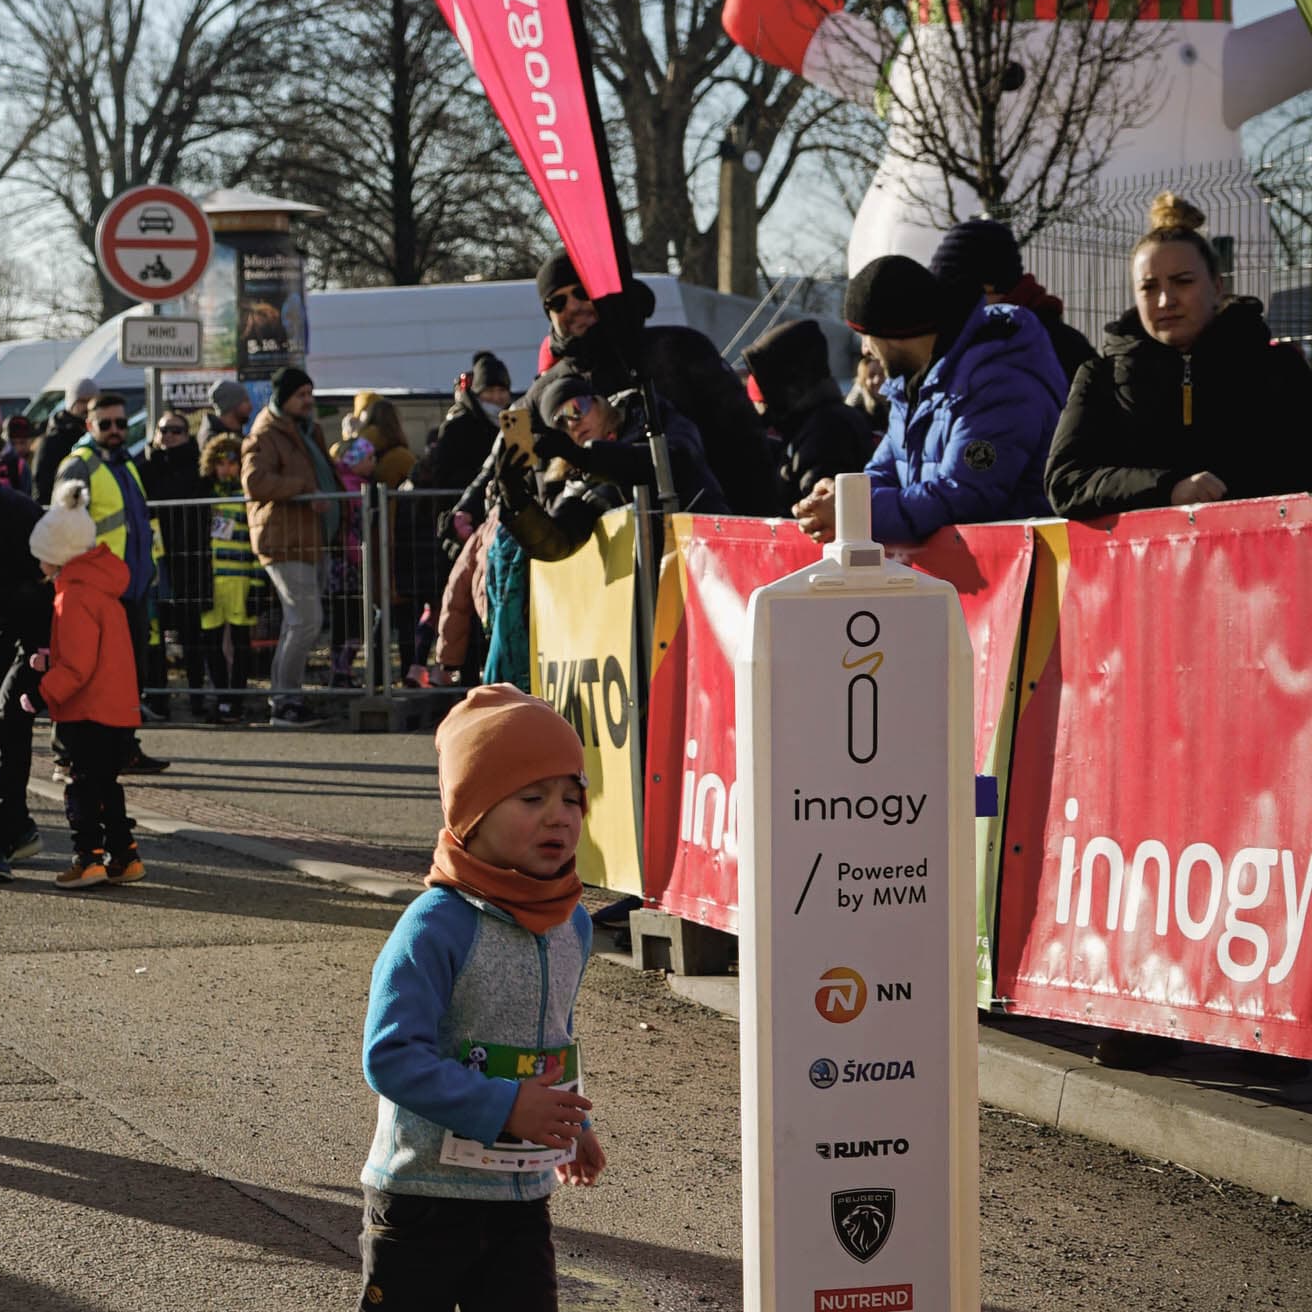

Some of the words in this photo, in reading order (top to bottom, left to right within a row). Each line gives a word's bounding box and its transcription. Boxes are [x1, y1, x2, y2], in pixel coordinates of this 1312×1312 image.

[793, 788, 928, 826] innogy
[838, 857, 929, 881] Powered
[837, 890, 864, 913] by
[873, 884, 928, 907] MVM
[876, 981, 912, 1002] NN
[841, 1058, 916, 1084] ŠKODA
[833, 1137, 910, 1159] RUNTO
[837, 1194, 890, 1205] PEUGEOT
[819, 1289, 909, 1312] NUTREND
